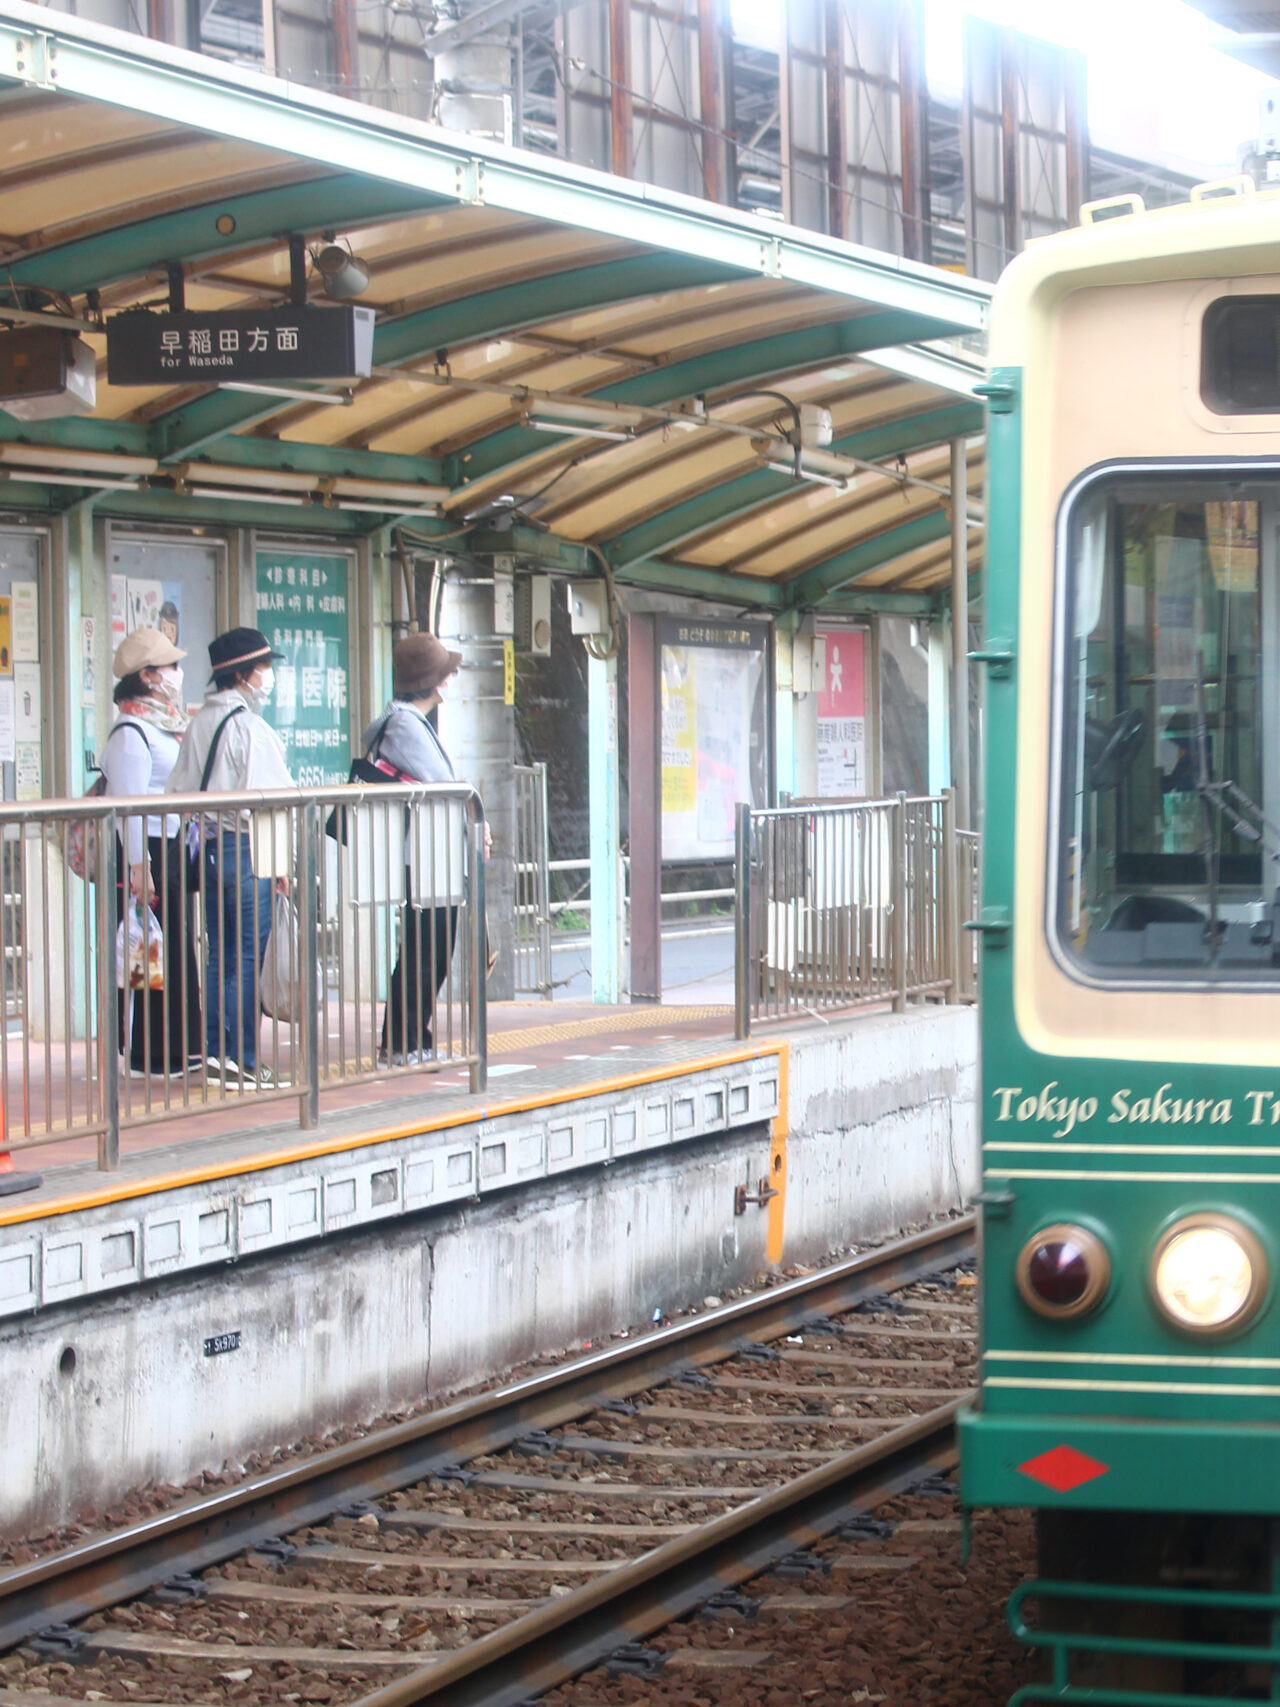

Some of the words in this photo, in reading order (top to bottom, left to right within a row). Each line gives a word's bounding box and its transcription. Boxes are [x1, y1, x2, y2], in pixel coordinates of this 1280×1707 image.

[160, 327, 299, 355] 早稲田方面
[161, 356, 181, 368] for
[188, 353, 234, 367] Waseda
[993, 1081, 1098, 1138] Tokyo
[1107, 1083, 1233, 1125] Sakura
